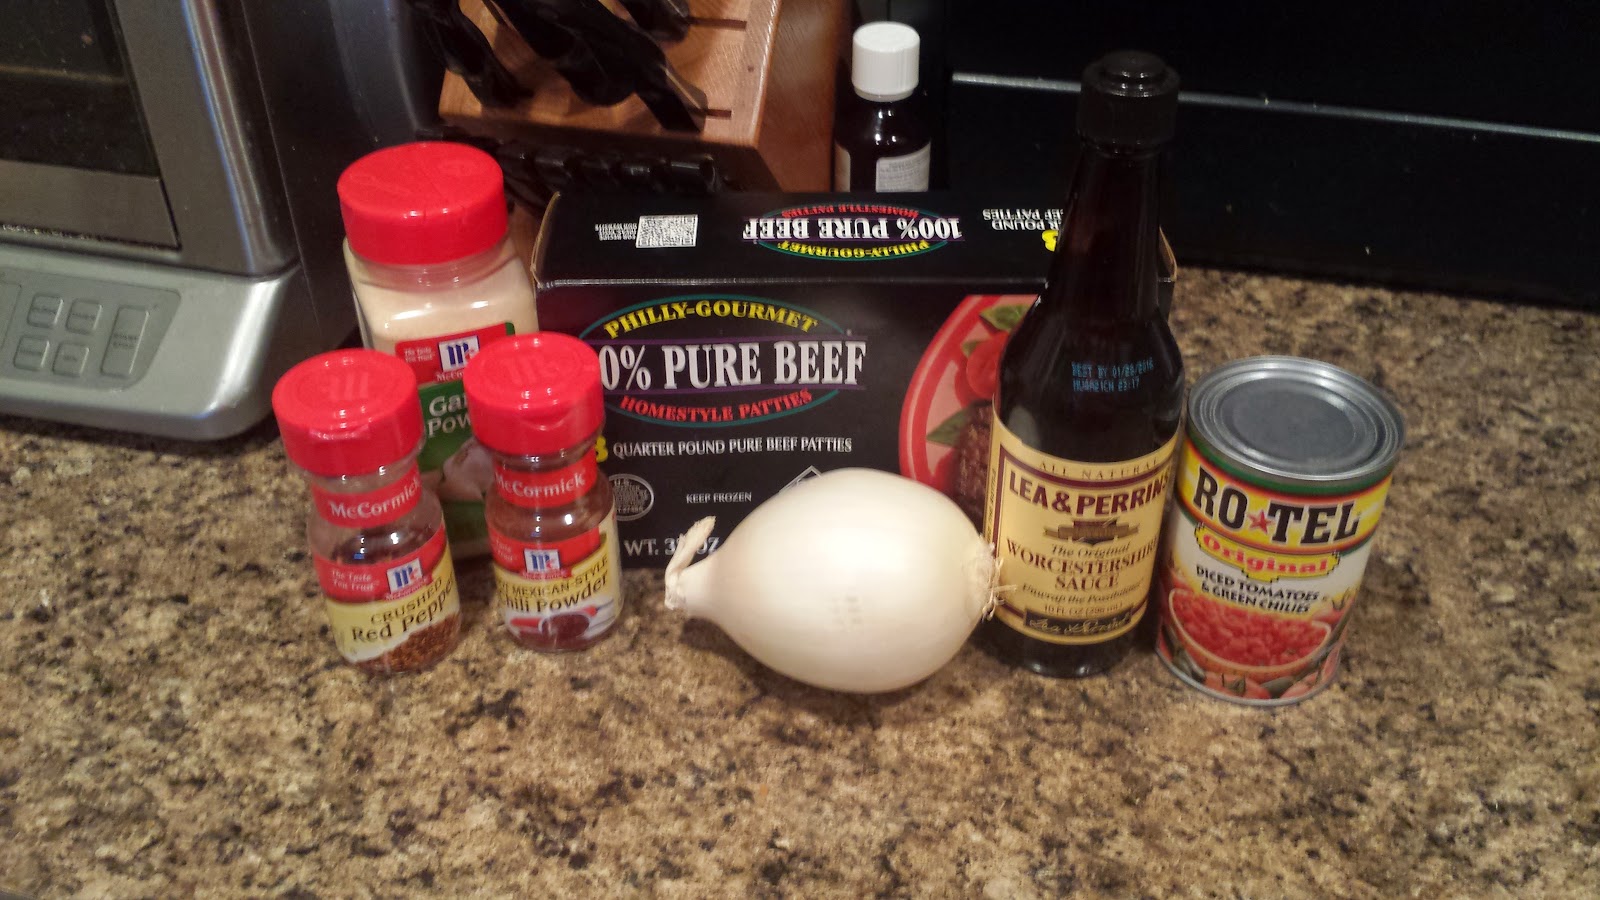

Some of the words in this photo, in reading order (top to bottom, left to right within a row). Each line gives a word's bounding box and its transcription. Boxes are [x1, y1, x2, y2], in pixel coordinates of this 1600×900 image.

[818, 217, 889, 239] PURE
[982, 208, 1041, 221] PATTIES
[991, 219, 1045, 231] POUND
[743, 217, 810, 240] BEEF
[896, 217, 962, 240] 100%
[603, 299, 819, 339] PHILLY-GOURMET
[598, 343, 652, 391] 0%
[661, 341, 762, 390] PURE
[773, 340, 867, 386] BEEF
[1071, 361, 1093, 378] BEST
[1097, 364, 1107, 379] BY
[620, 394, 734, 423] HOMESTYLE
[738, 387, 813, 421] PATTIES
[427, 410, 471, 438] Pow
[613, 441, 675, 460] QUARTER
[678, 439, 726, 456] POUND
[729, 437, 763, 454] PURE
[766, 436, 798, 452] BEEF
[801, 436, 853, 453] PATTIES
[328, 477, 422, 519] McCormick
[495, 472, 585, 498] McCormick
[686, 492, 711, 504] KEEP
[713, 491, 752, 503] FROZEN
[1009, 470, 1049, 510] LEA
[1051, 490, 1072, 514] &
[1076, 470, 1169, 516] PERRINS
[623, 538, 659, 557] WT.
[1078, 541, 1131, 560] Original
[1202, 533, 1329, 573] Original
[504, 592, 529, 613] hili
[536, 570, 608, 612] Powder
[1055, 574, 1119, 592] SAUCE
[1196, 563, 1235, 586] DICED
[1238, 578, 1320, 601] TOMATOES
[351, 623, 393, 642] Red
[402, 574, 454, 632] Peppe
[370, 577, 442, 625] CRUSHED
[1212, 585, 1257, 606] GREEN
[1259, 598, 1310, 614] CHILIES
